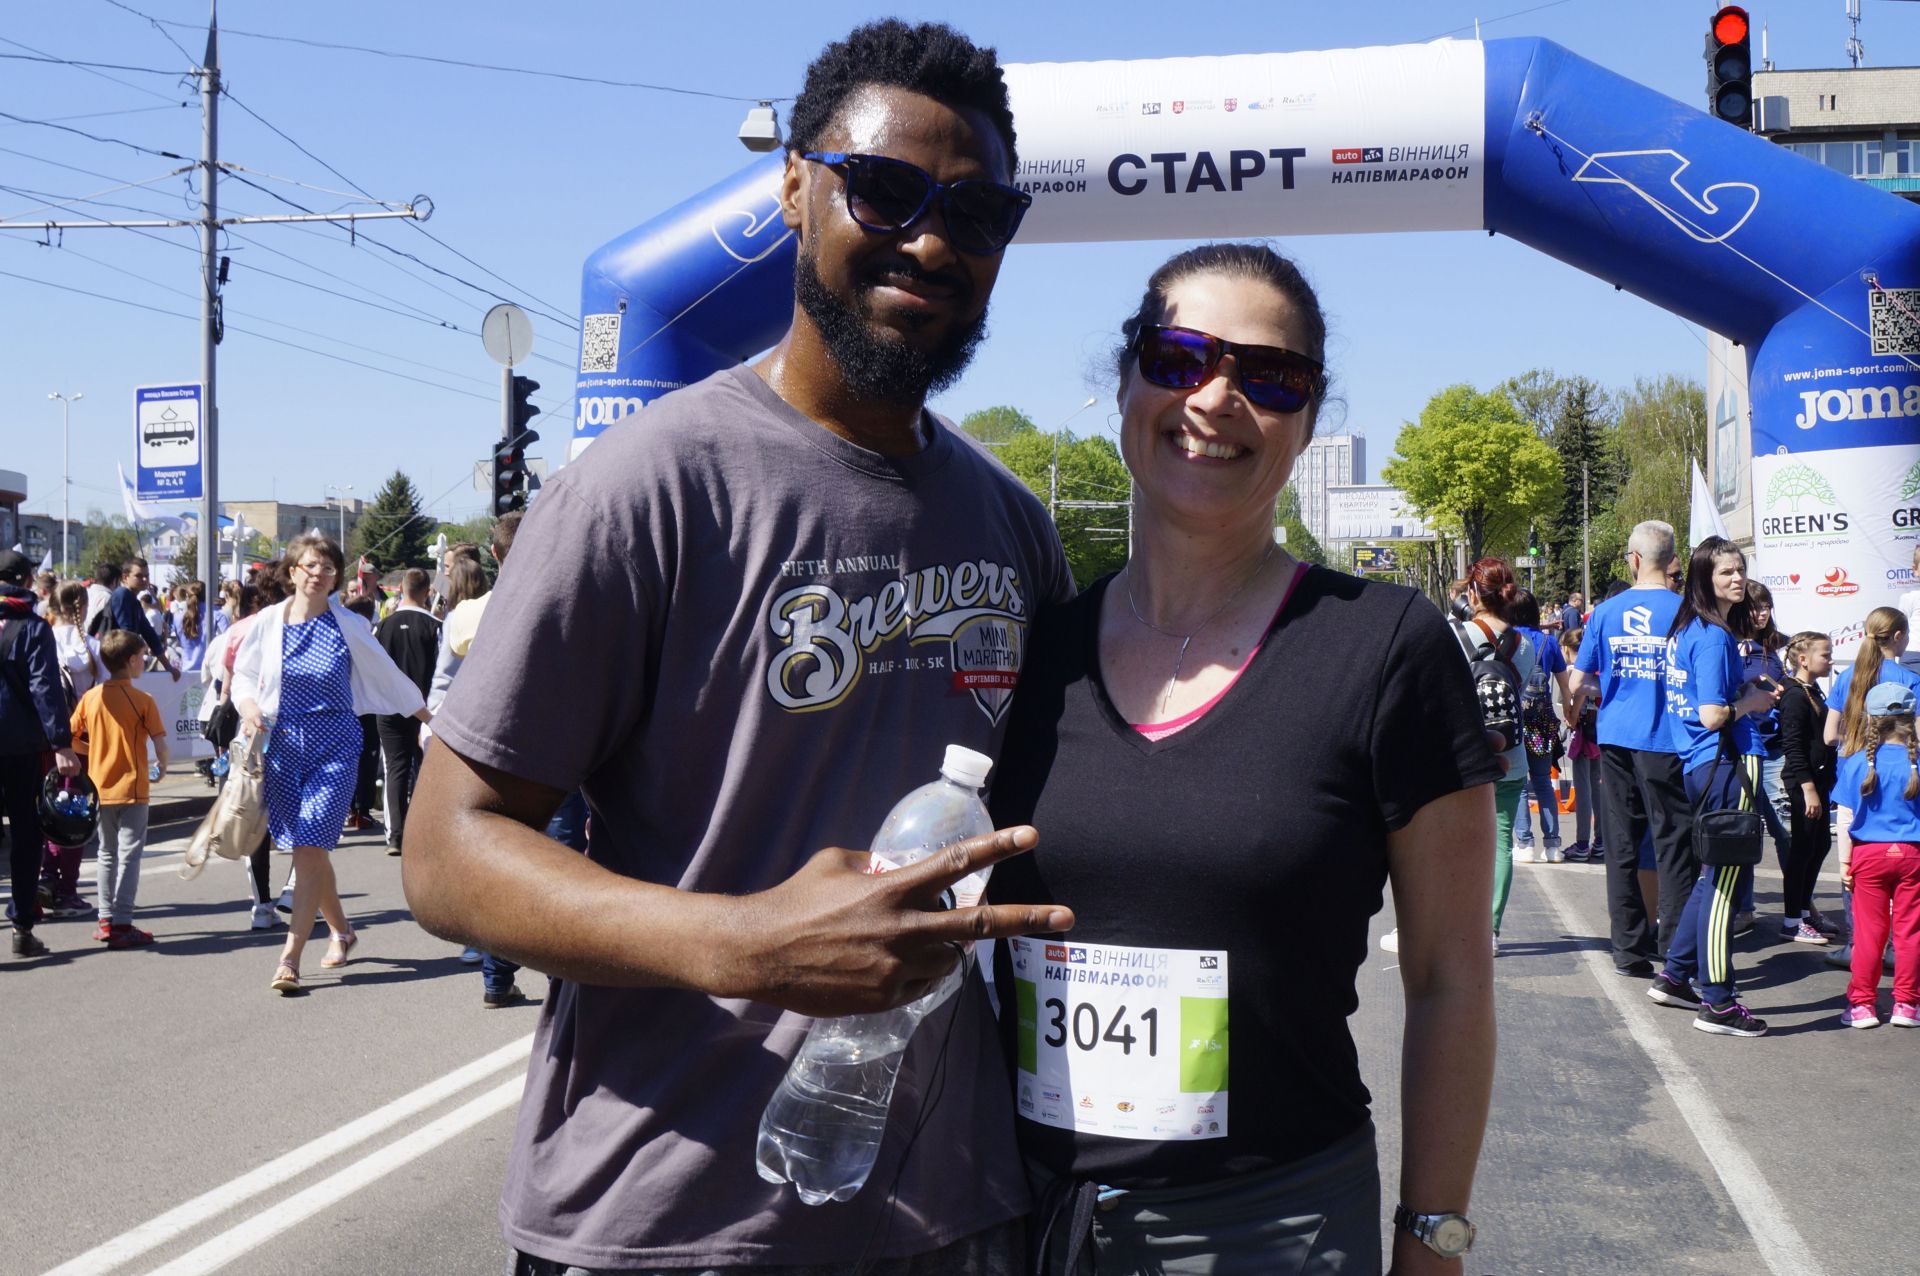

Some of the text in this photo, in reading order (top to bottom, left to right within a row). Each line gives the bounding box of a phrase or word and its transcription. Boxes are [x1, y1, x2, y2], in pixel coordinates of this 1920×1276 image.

[1335, 151, 1358, 161] auto
[1388, 143, 1469, 162] ВІННИЦЯ
[1107, 147, 1306, 196] СТАРТ
[1331, 166, 1470, 184] НАПІВМАРАФОН
[576, 396, 660, 431] Jom
[1762, 512, 1849, 536] GREEN'S
[781, 554, 900, 577] FIFTH ANNUAL
[767, 559, 1026, 713] Brewers
[980, 626, 1008, 649] MINI
[868, 657, 945, 674] HALF 10K 5K
[175, 719, 200, 732] GREE
[1047, 950, 1066, 959] auto
[1092, 949, 1169, 972] ВІННИЦЯ
[1044, 965, 1169, 988] НАПІВМАРАФОН
[1044, 997, 1158, 1057] 3041
